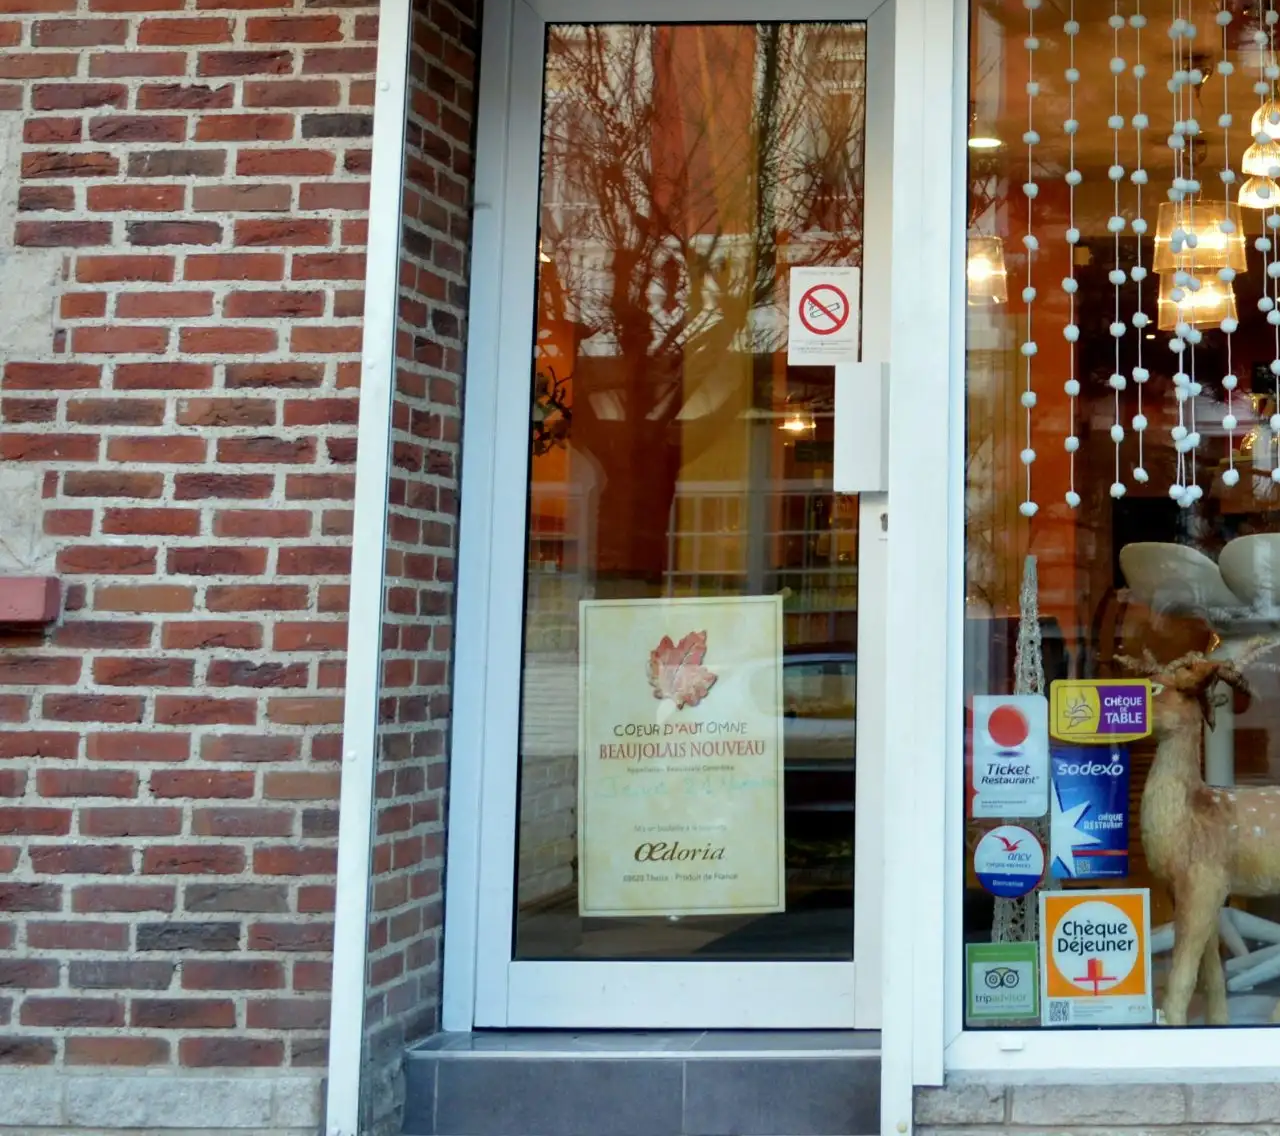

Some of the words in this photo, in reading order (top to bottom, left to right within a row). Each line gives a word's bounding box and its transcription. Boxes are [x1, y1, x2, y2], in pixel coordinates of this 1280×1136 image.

[1104, 695, 1143, 707] CHÈQUE
[1104, 712, 1143, 724] TABLE
[613, 723, 660, 737] COEUR
[663, 721, 748, 736] D'AUTOMNE
[600, 742, 686, 761] BEAUJOLAIS
[690, 739, 765, 757] NOUVEAU
[987, 763, 1031, 775] Ticket
[1057, 760, 1124, 776] sodexo
[1062, 920, 1128, 938] Chèque
[1057, 937, 1134, 956] Déjeuner
